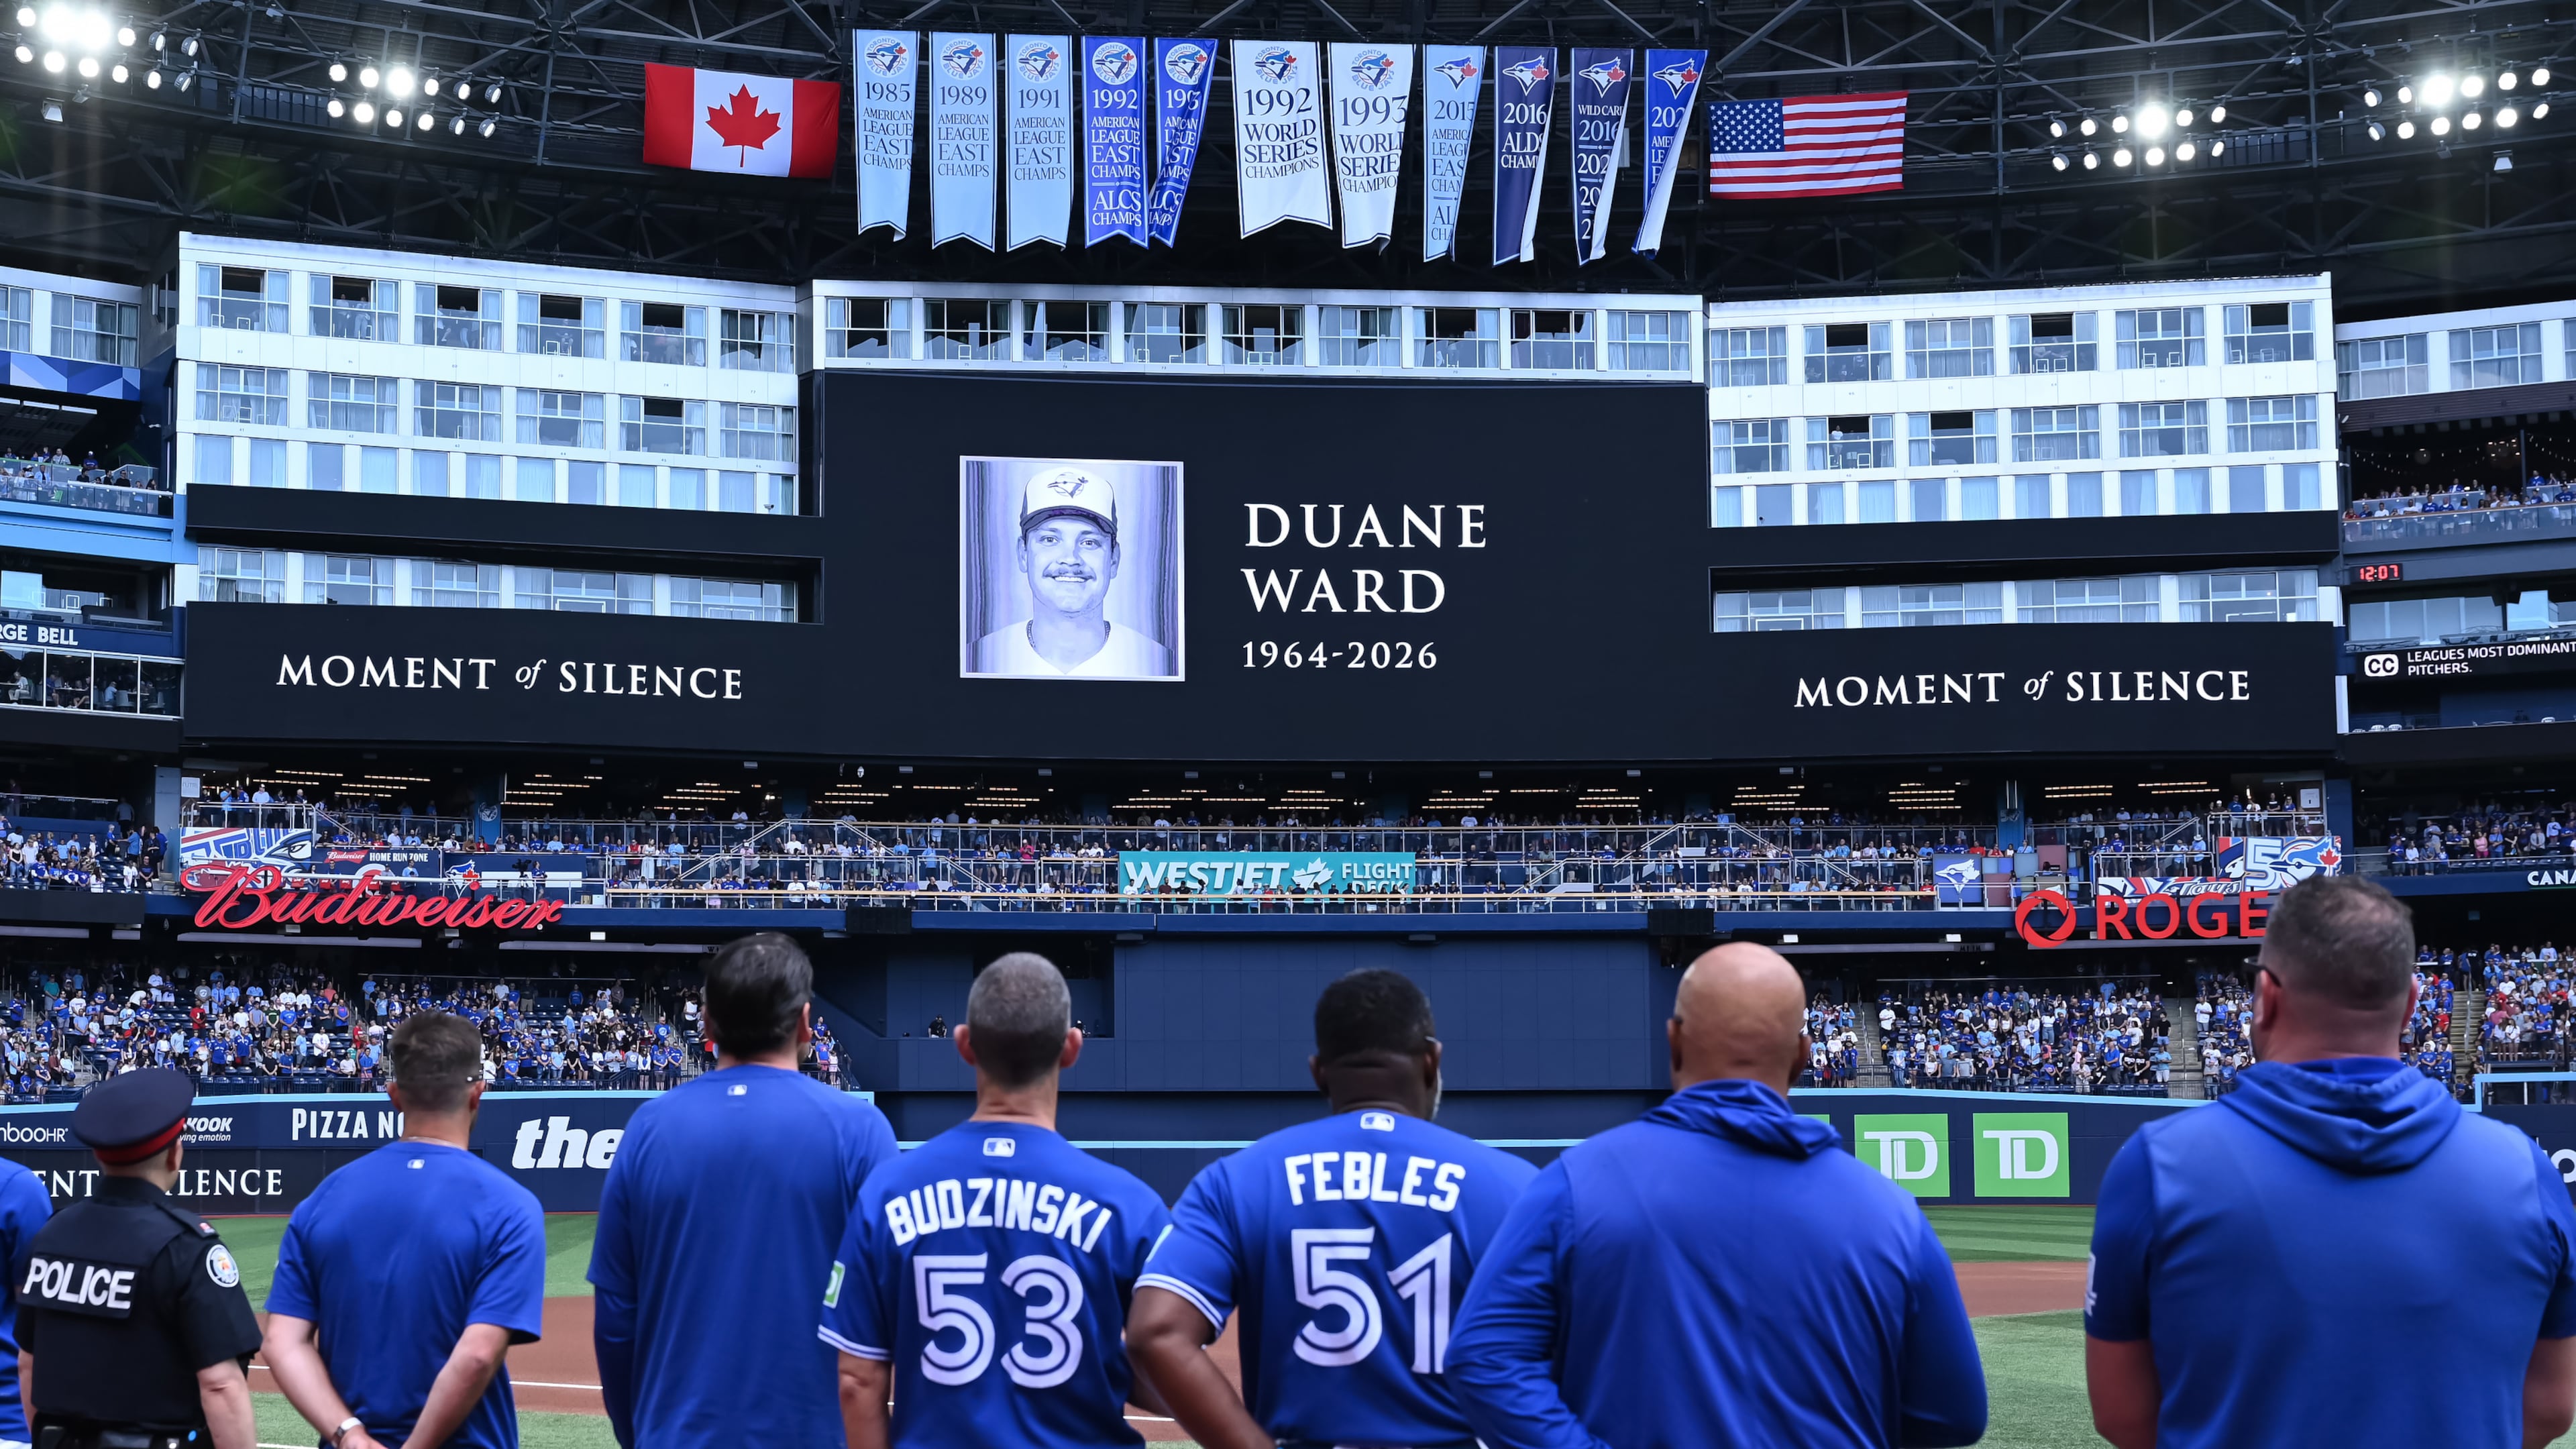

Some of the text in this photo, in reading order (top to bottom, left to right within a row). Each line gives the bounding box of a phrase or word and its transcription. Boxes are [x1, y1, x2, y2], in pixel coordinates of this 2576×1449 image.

[867, 38, 896, 52] TORONTO
[944, 40, 971, 54] TORONTO
[1020, 43, 1047, 57] TORONTO
[1096, 44, 1124, 58] TORONTO
[1255, 46, 1285, 62] TORONTO
[1352, 49, 1382, 65] TORONTO
[867, 60, 887, 76] BLUE
[943, 62, 963, 79] BLUE
[1019, 65, 1040, 81] BLUE
[1095, 67, 1115, 83] BLUE
[1256, 69, 1278, 85] BLUE
[865, 81, 910, 102] 1985
[1352, 74, 1374, 91] BLUE
[940, 85, 987, 105] 1989
[1018, 89, 1061, 109] 1991
[1092, 89, 1138, 109] 1992
[1244, 88, 1312, 116] 1992
[863, 107, 912, 121] AMERICAN
[938, 113, 989, 125] AMERICAN
[1339, 95, 1407, 126] 1993
[1433, 100, 1475, 122] 2015
[1503, 103, 1547, 125] 2016
[1578, 105, 1601, 115] WILD
[863, 119, 913, 136] LEAGUE
[1014, 117, 1065, 128] AMERICAN
[1091, 116, 1140, 129] AMERICAN
[1244, 119, 1316, 142] WORLD
[938, 127, 989, 142] LEAGUE
[1015, 131, 1065, 144] LEAGUE
[1091, 129, 1140, 145] LEAGUE
[864, 135, 913, 156] EAST
[938, 143, 989, 162] EAST
[1091, 145, 1140, 164] EAST
[1244, 138, 1318, 163] SERIES
[864, 154, 912, 171] CHAMPS
[1015, 147, 1065, 165] EAST
[938, 164, 989, 177] CHAMPS
[1014, 168, 1066, 180] CHAMPS
[1091, 165, 1140, 179] CHAMPS
[1246, 156, 1320, 178] CHAMPIONS
[1093, 189, 1141, 212] ALCS
[1149, 190, 1183, 213] LCS
[1092, 211, 1142, 227] CHAMPS
[1581, 218, 1593, 239] 2
[1244, 503, 1486, 548] DUANE
[2359, 564, 2399, 581] 12:07
[1240, 568, 1445, 613] WARD
[38, 626, 78, 645] BELL
[1242, 641, 1437, 669] 1964-2026
[2407, 641, 2576, 663] LEAGUES MOST DOMINANT
[2367, 656, 2396, 675] CC
[2408, 661, 2473, 676] PITCHERS.
[276, 654, 741, 699] MOMENT of SILENCE
[1794, 671, 2249, 707] MOMENT of SILENCE
[327, 851, 365, 860] Budweiser
[370, 853, 429, 862] HOME RUN ZONE
[1123, 862, 1289, 894] WESTJET
[1342, 863, 1413, 879] FLIGHT
[2528, 870, 2576, 886] CANA
[180, 863, 563, 928] Budweiser
[1352, 881, 1403, 894] DECK
[2096, 891, 2268, 940] ROGE
[292, 1108, 369, 1140] PIZZA
[199, 1132, 231, 1142] emotion
[512, 1116, 625, 1169] the
[1864, 1130, 1938, 1180] TD
[1982, 1130, 2059, 1179] TD
[166, 1169, 282, 1196] LENCE
[1285, 1151, 1466, 1212] FEBLES
[885, 1178, 1112, 1253] BUDZINSKI
[22, 1258, 135, 1309] POLICE
[1291, 1226, 1453, 1374] 51
[913, 1252, 1085, 1388] 53
